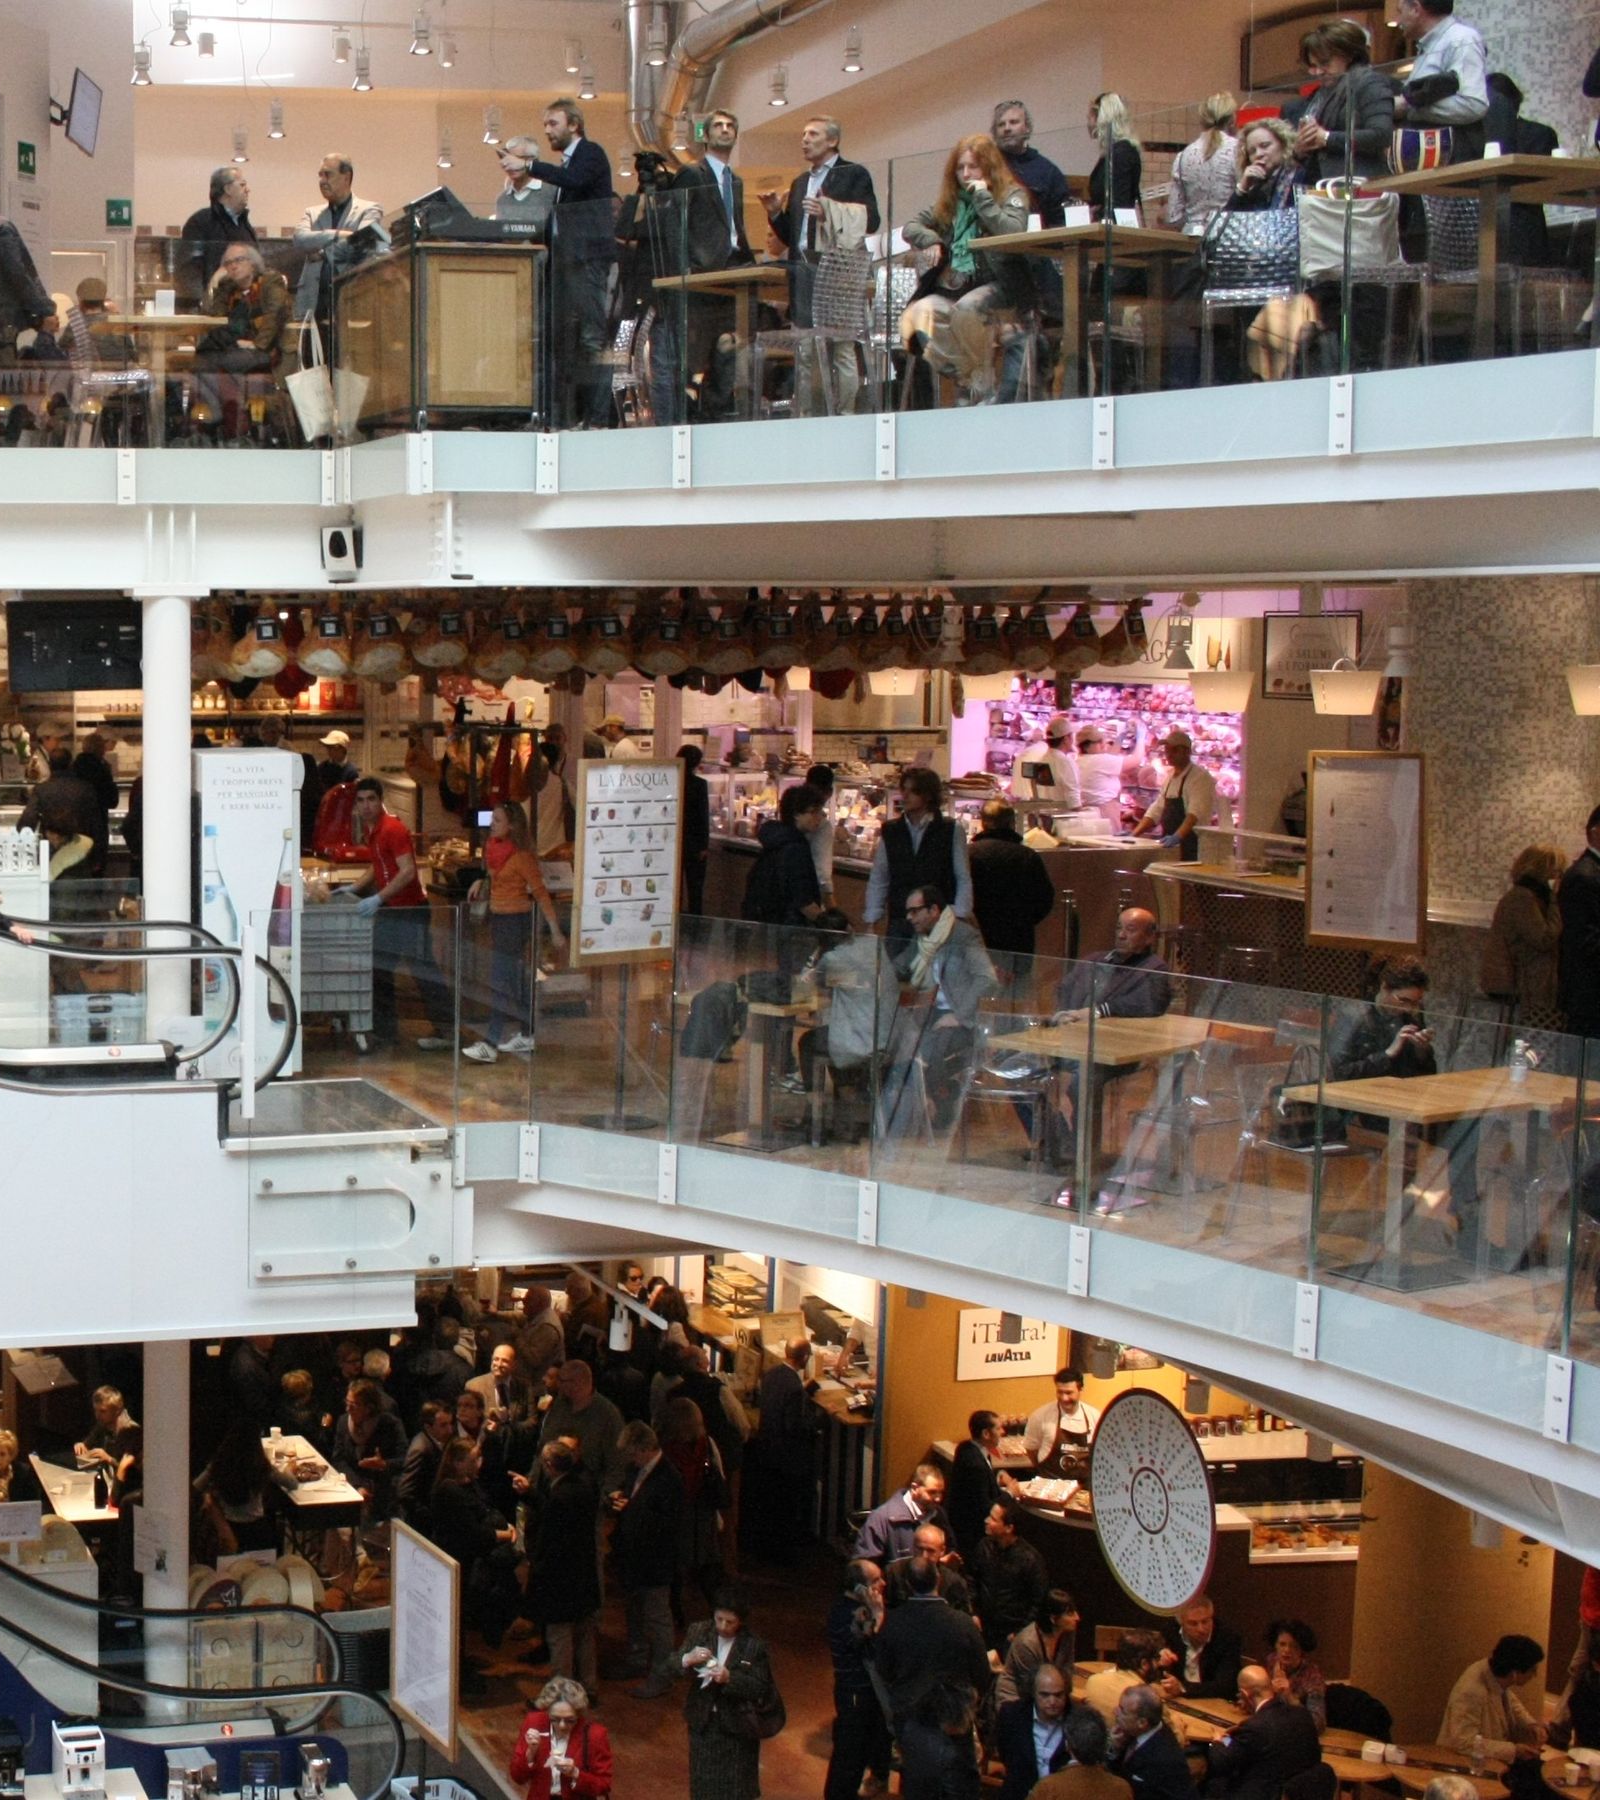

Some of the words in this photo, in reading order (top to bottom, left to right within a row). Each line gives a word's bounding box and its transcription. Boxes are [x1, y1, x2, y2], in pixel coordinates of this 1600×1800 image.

[598, 773, 615, 788] LA
[619, 771, 670, 791] PASQUA
[971, 1320, 1047, 1345] ¡Tira!
[984, 1348, 1032, 1364] LAVAZZA
